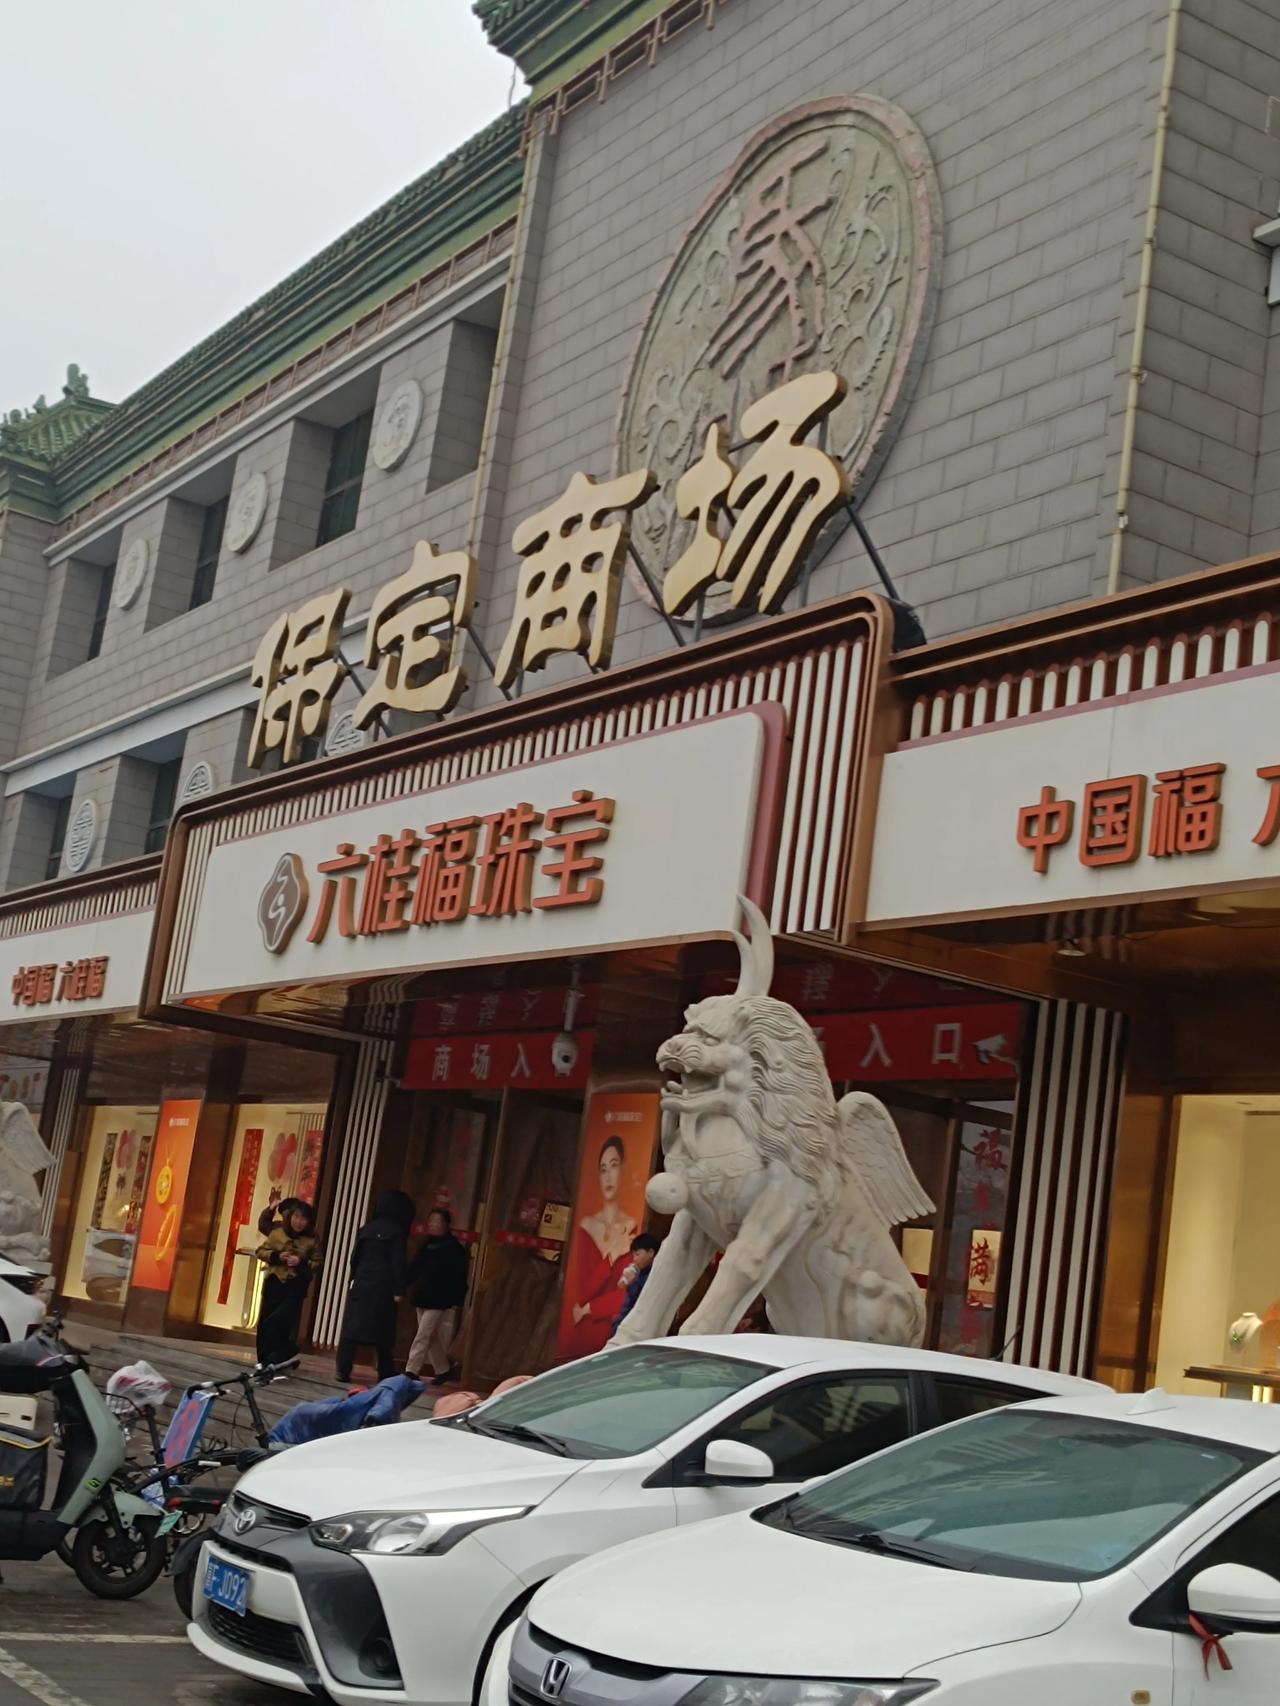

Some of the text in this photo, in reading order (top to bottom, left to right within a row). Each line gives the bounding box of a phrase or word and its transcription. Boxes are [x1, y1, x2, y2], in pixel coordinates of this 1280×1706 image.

[248, 371, 850, 768] 保定商场
[306, 790, 616, 943] 六桂福珠宝
[431, 1042, 572, 1081] 商场入
